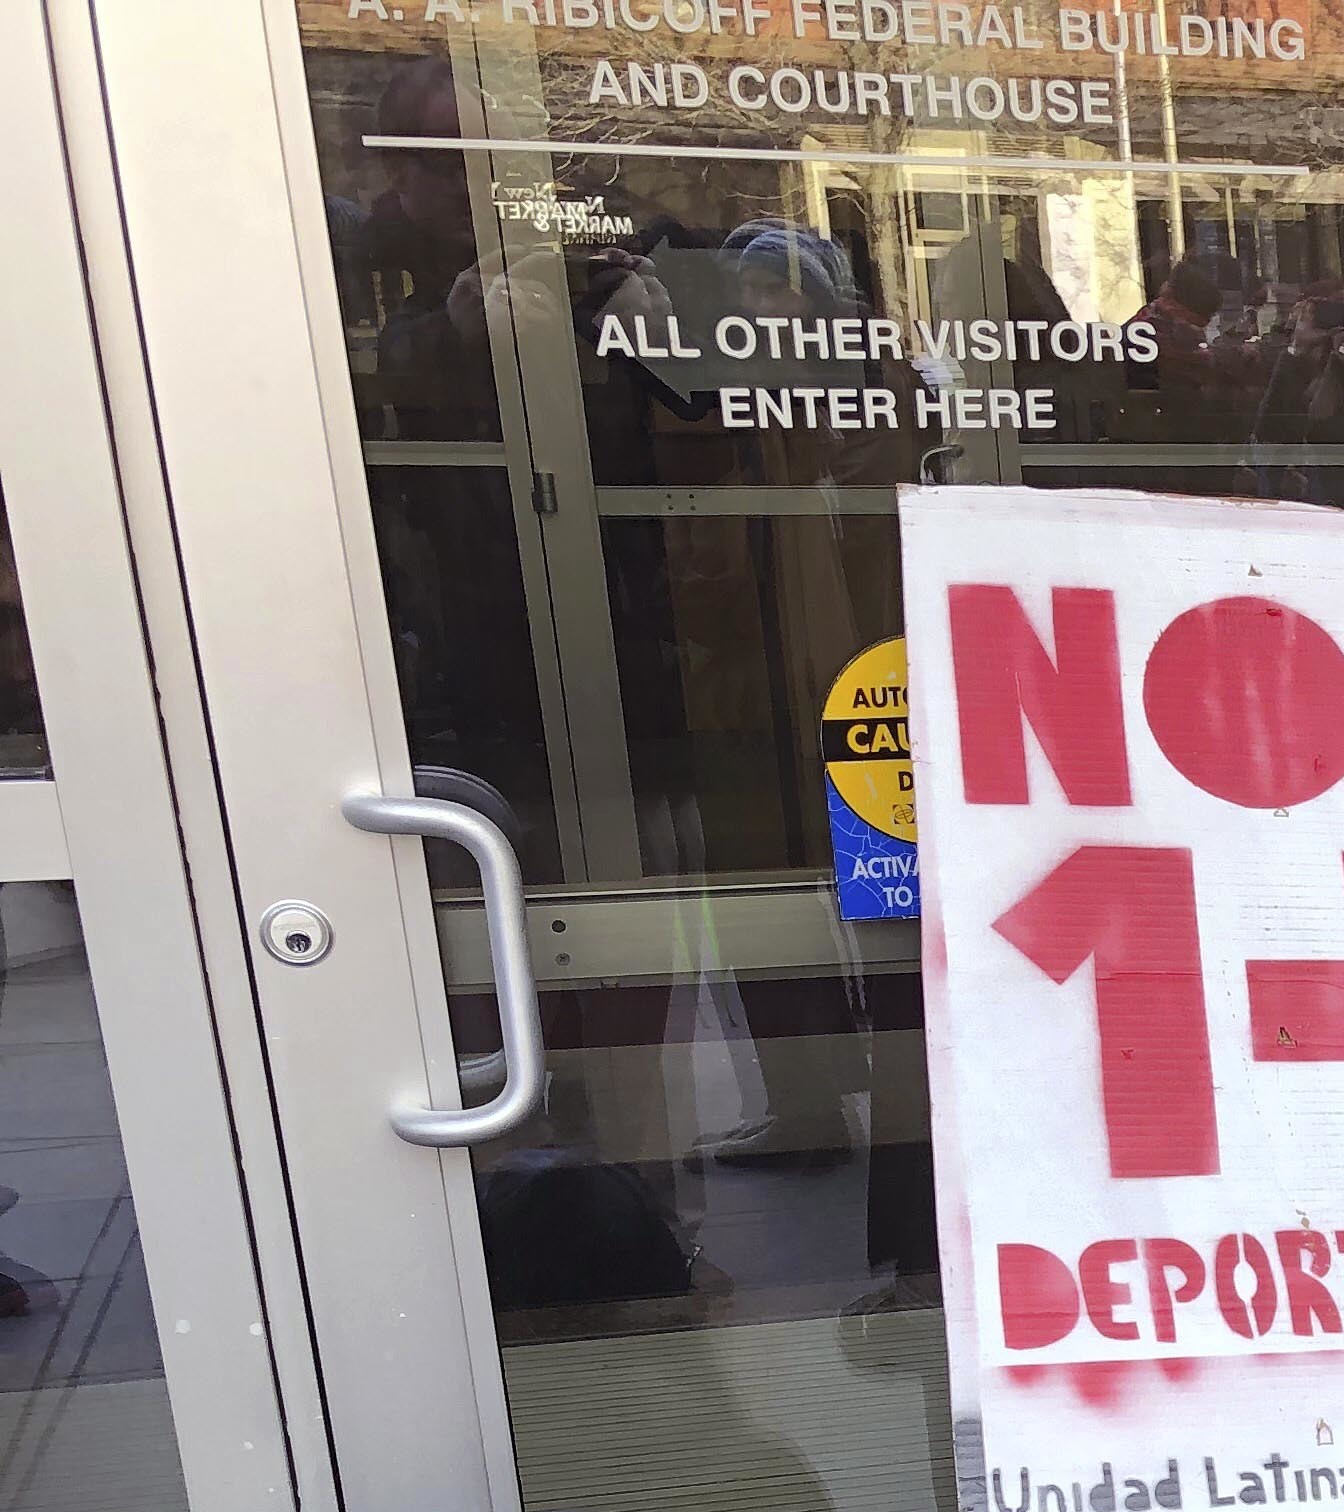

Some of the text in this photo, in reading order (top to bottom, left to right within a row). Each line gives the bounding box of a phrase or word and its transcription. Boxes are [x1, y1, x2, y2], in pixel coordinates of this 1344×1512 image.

[502, 0, 773, 36] RIBICOFF
[793, 0, 1044, 49] FEDERAL
[1059, 9, 1306, 61] BUILDING
[589, 60, 1114, 125] AND COURTHOUSE
[596, 314, 1159, 363] ALL OTHER VISITORS
[720, 386, 1057, 430] ENTER HERE
[883, 886, 913, 908] TO
